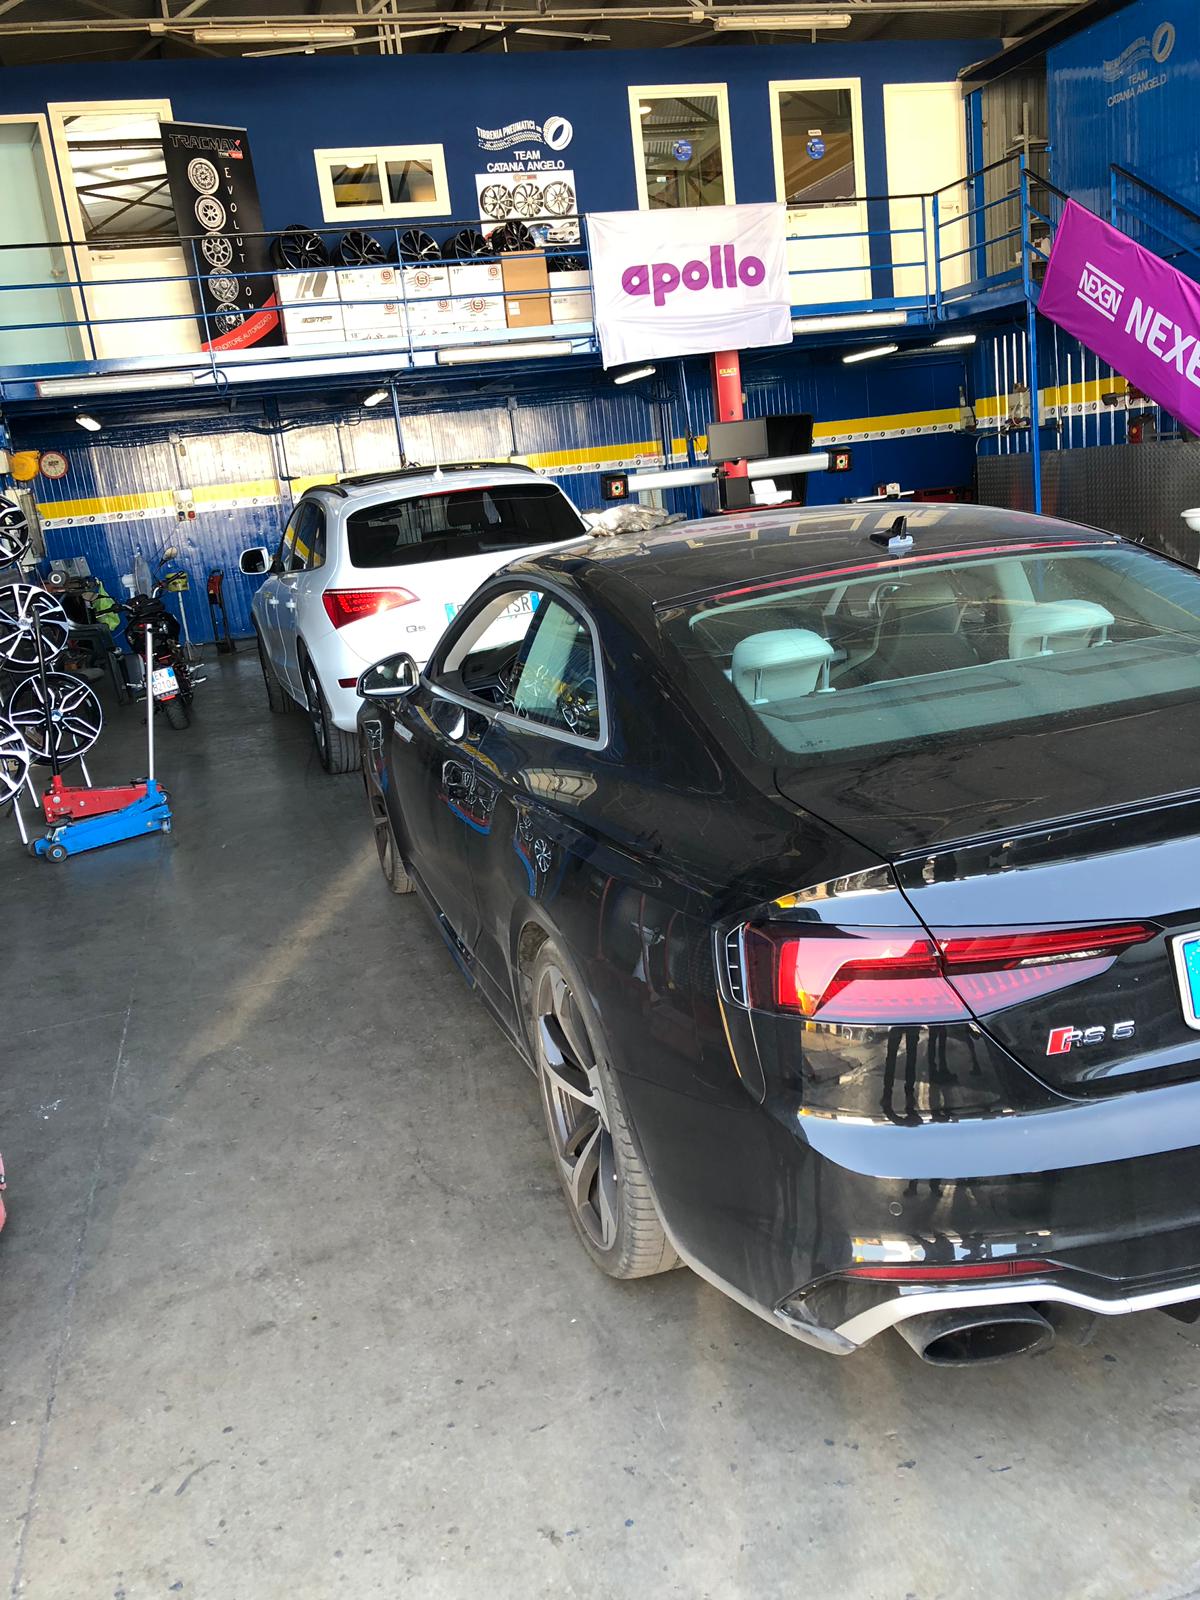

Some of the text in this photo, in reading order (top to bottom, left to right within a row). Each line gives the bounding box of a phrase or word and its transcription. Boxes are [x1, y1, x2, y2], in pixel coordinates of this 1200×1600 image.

[1128, 69, 1148, 85] TEAM
[168, 134, 243, 152] TRACMAX
[513, 150, 541, 161] TEAM
[486, 160, 565, 173] CATANIA ANGELO
[621, 244, 766, 307] apollo
[1078, 268, 1123, 316] NEXEN
